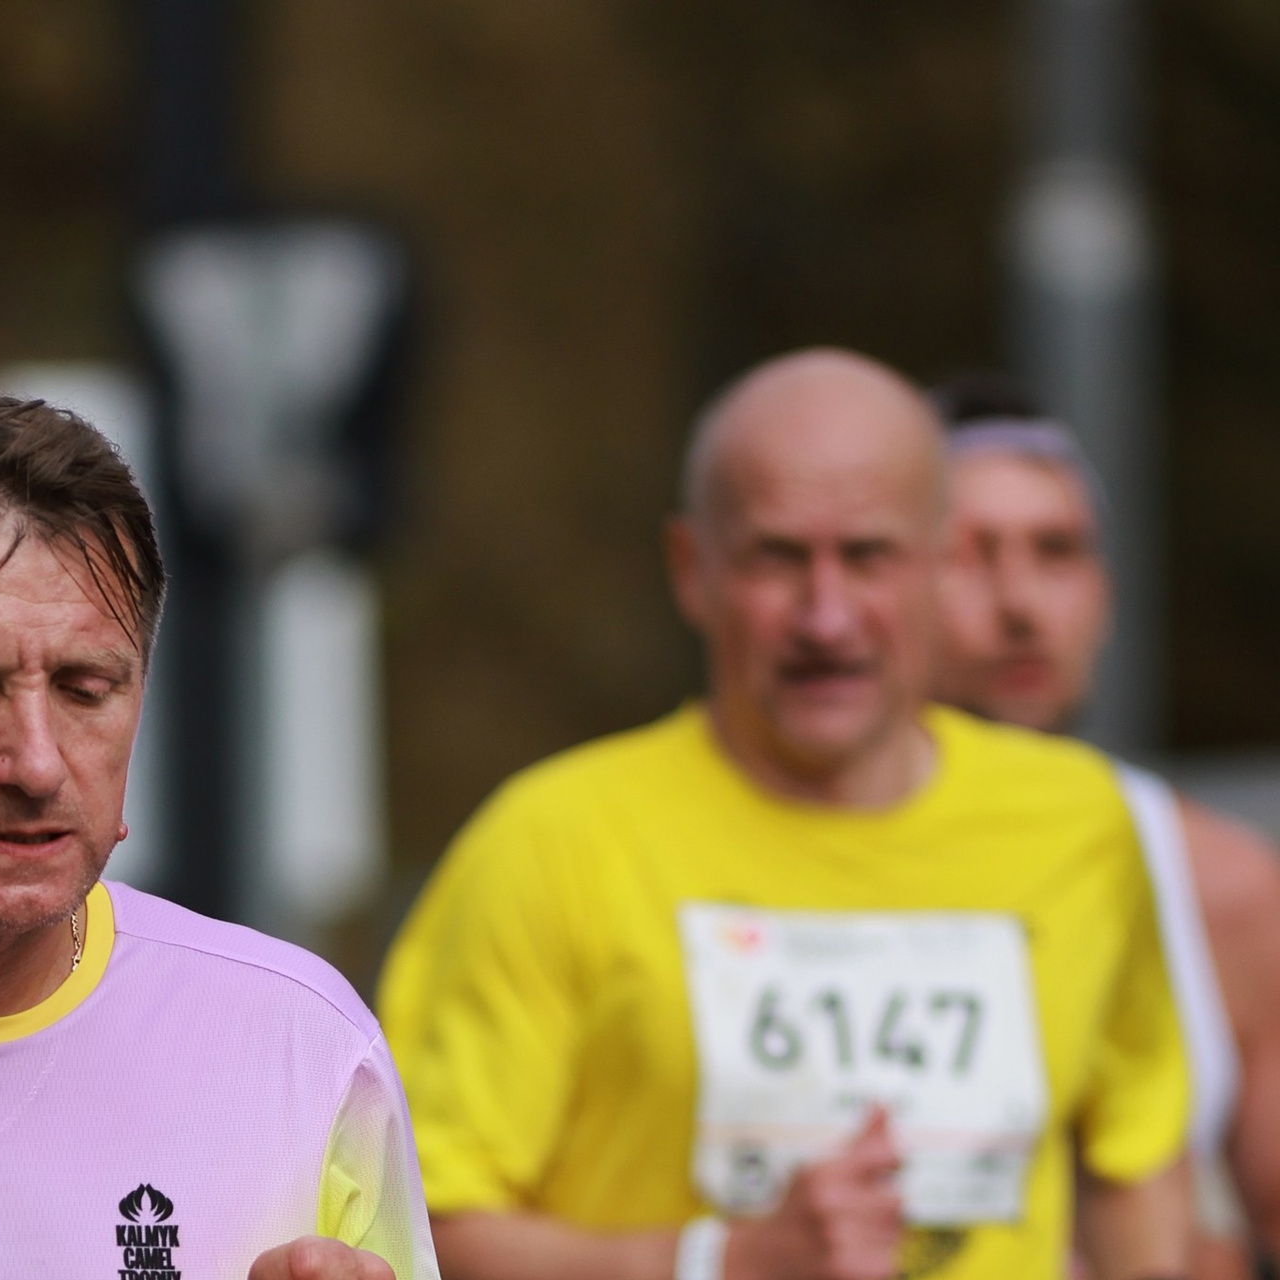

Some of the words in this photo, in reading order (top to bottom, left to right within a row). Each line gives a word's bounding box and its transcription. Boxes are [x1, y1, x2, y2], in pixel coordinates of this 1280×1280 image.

[748, 983, 983, 1078] 6147
[116, 1225, 180, 1247] KALMYK
[123, 1248, 175, 1270] CAMEL
